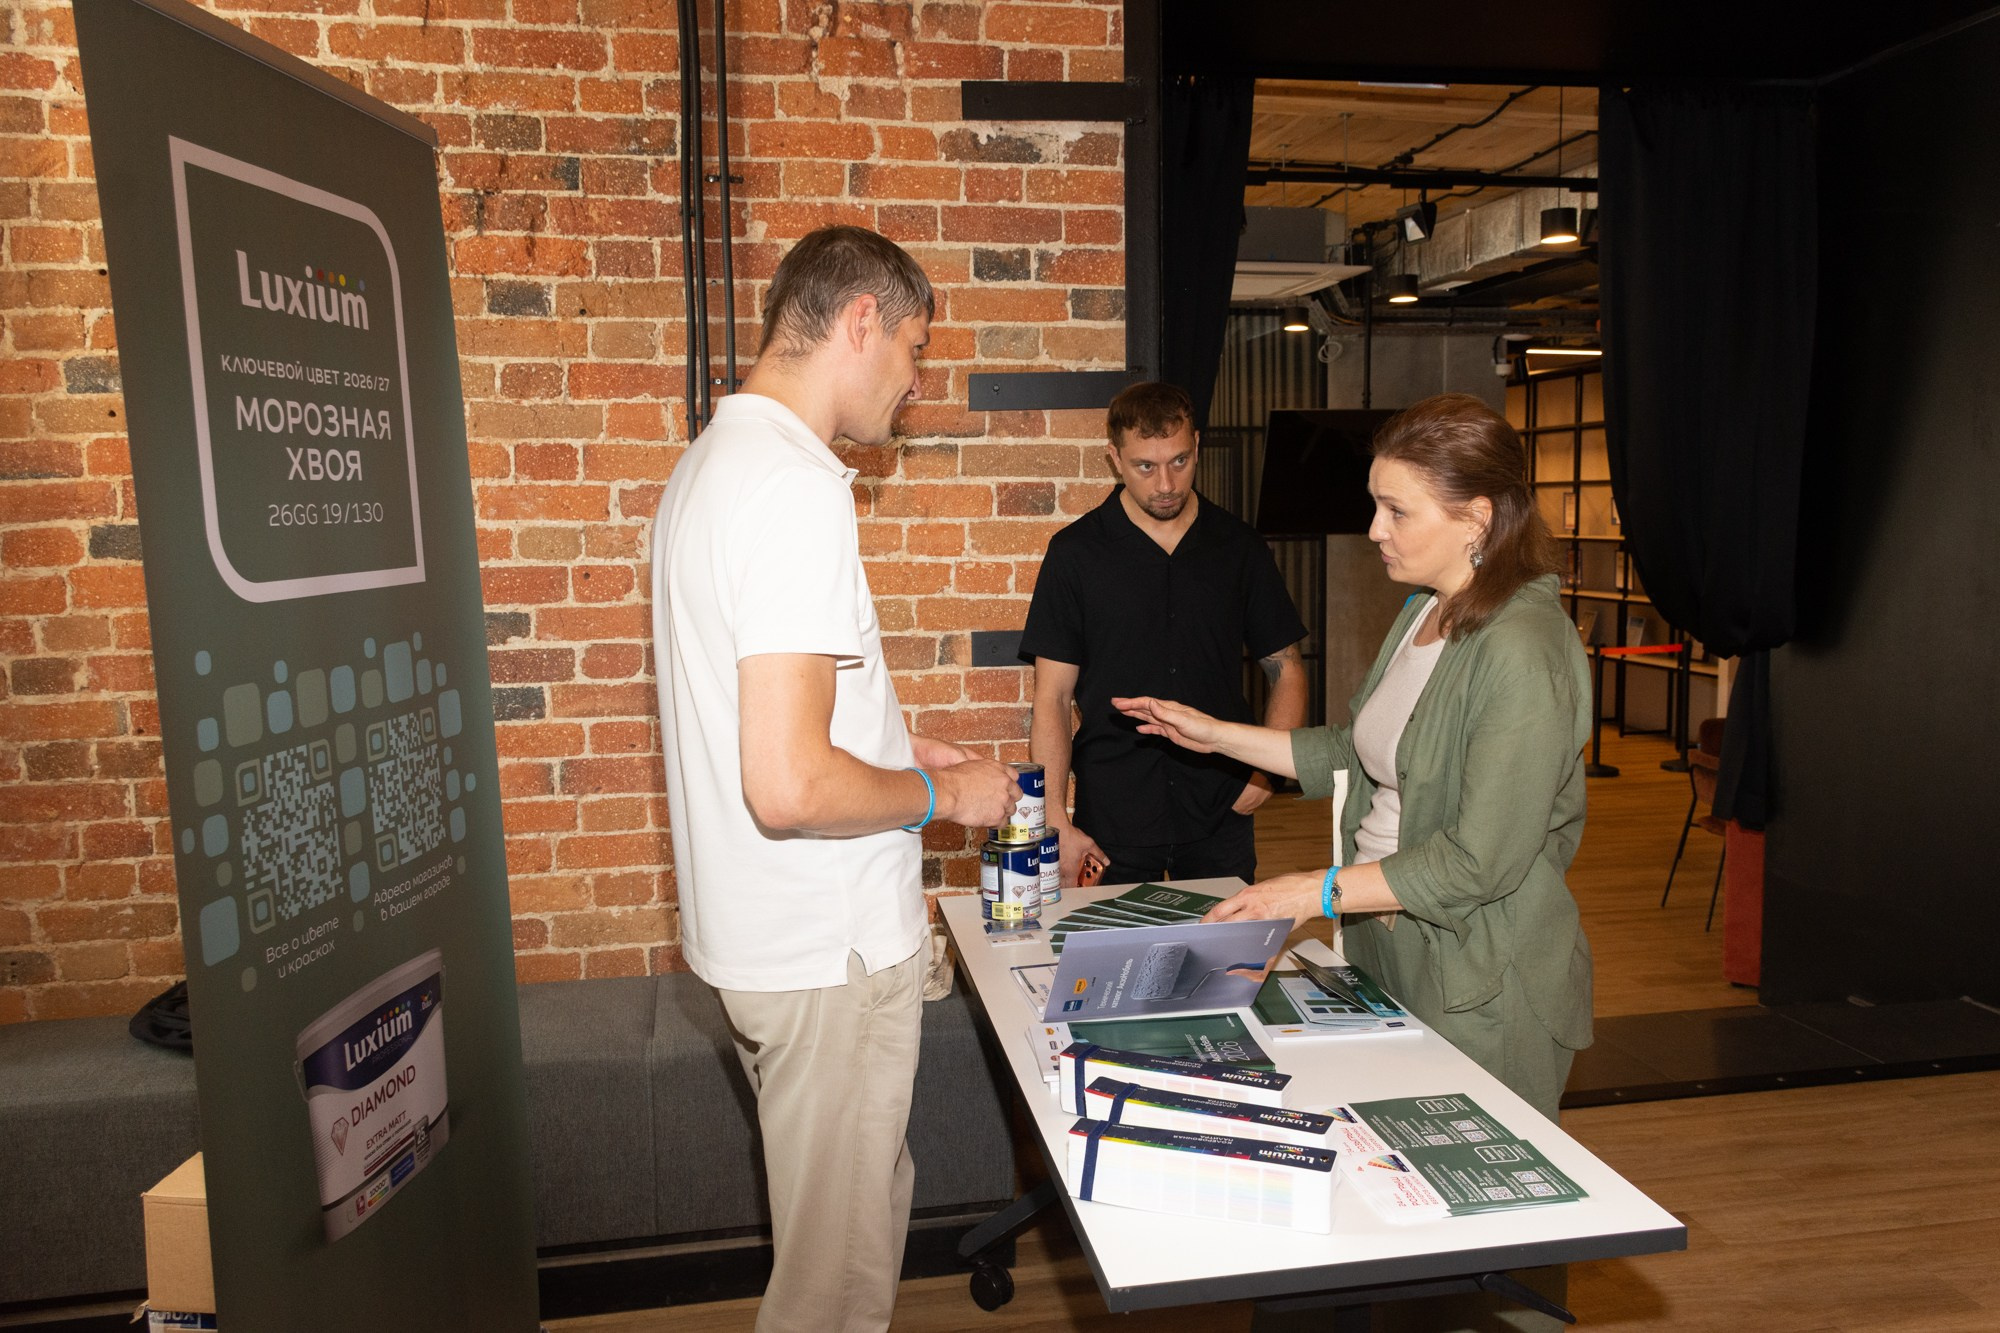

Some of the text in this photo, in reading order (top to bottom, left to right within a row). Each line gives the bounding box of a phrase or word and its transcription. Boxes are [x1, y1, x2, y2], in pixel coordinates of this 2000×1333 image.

[235, 249, 369, 330] Luxium
[220, 354, 390, 392] КЛЮЧЕВОЙ ЦВЕТ 2026/27
[235, 395, 392, 441] МОРОЗНАЯ
[285, 446, 363, 481] ХВОЯ
[268, 501, 384, 527] 26GG 19/130
[373, 854, 453, 906] Адреса магазинов
[390, 892, 423, 917] вашем
[424, 875, 451, 899] городе
[266, 917, 340, 964] Все о цвете
[278, 939, 336, 978] и красках
[344, 1008, 413, 1072] Luxium
[1217, 1041, 1250, 1061] 2026
[351, 1065, 416, 1127] DIAMOND
[1221, 1072, 1270, 1085] Luxium
[366, 1110, 407, 1149] EXTRA MATT
[1259, 1113, 1312, 1127] Luxium
[1258, 1149, 1315, 1164] Luxium
[1275, 1144, 1304, 1152] Dulux
